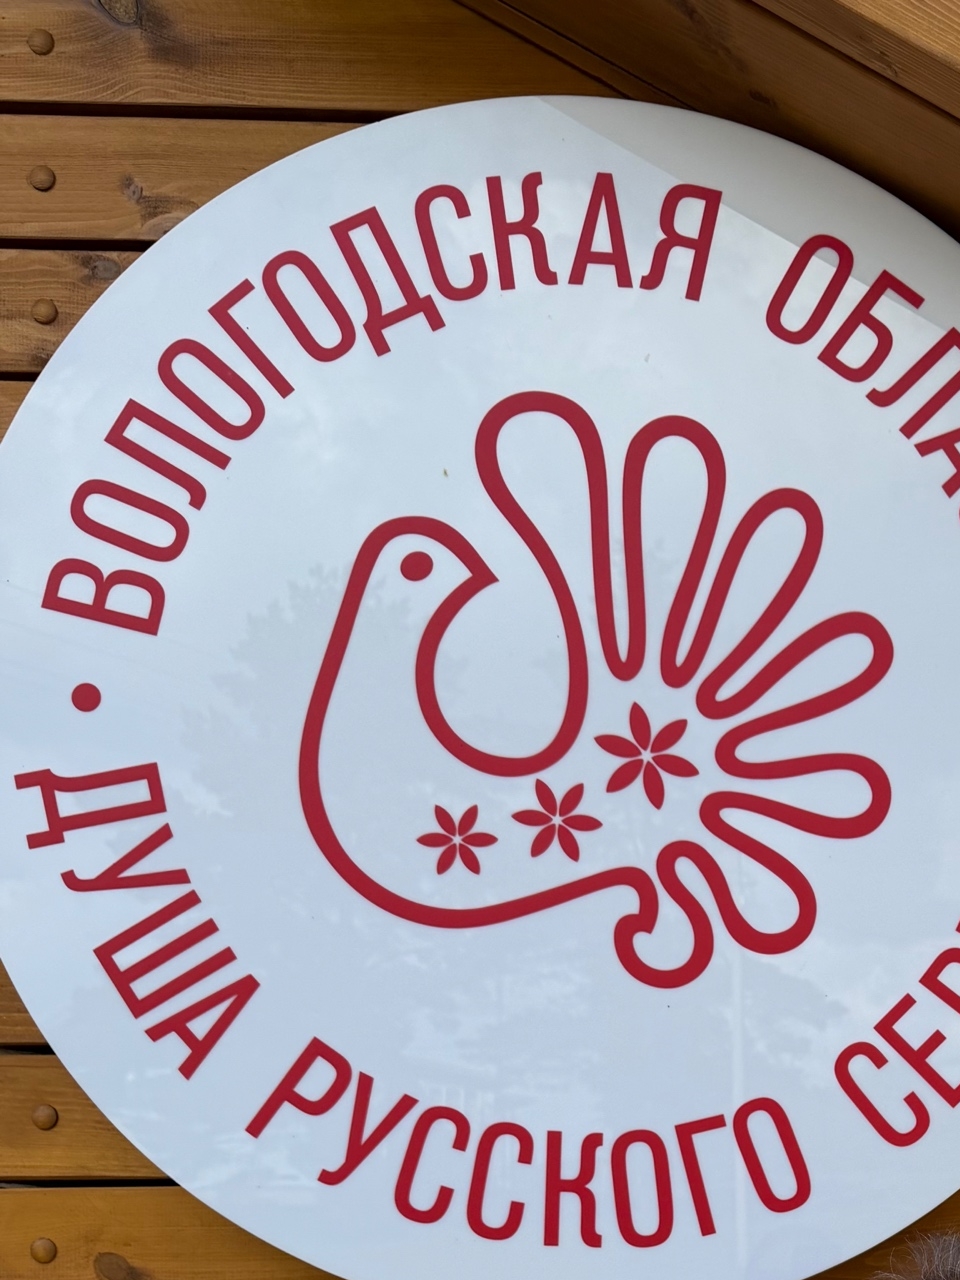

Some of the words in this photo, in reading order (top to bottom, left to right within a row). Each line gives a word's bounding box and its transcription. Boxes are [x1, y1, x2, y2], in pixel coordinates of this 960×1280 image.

[41, 172, 723, 636] ВОЛОГОДСКАЯ
[14, 762, 260, 1080] ДУША
[245, 1037, 811, 1248] РУССКОГО
